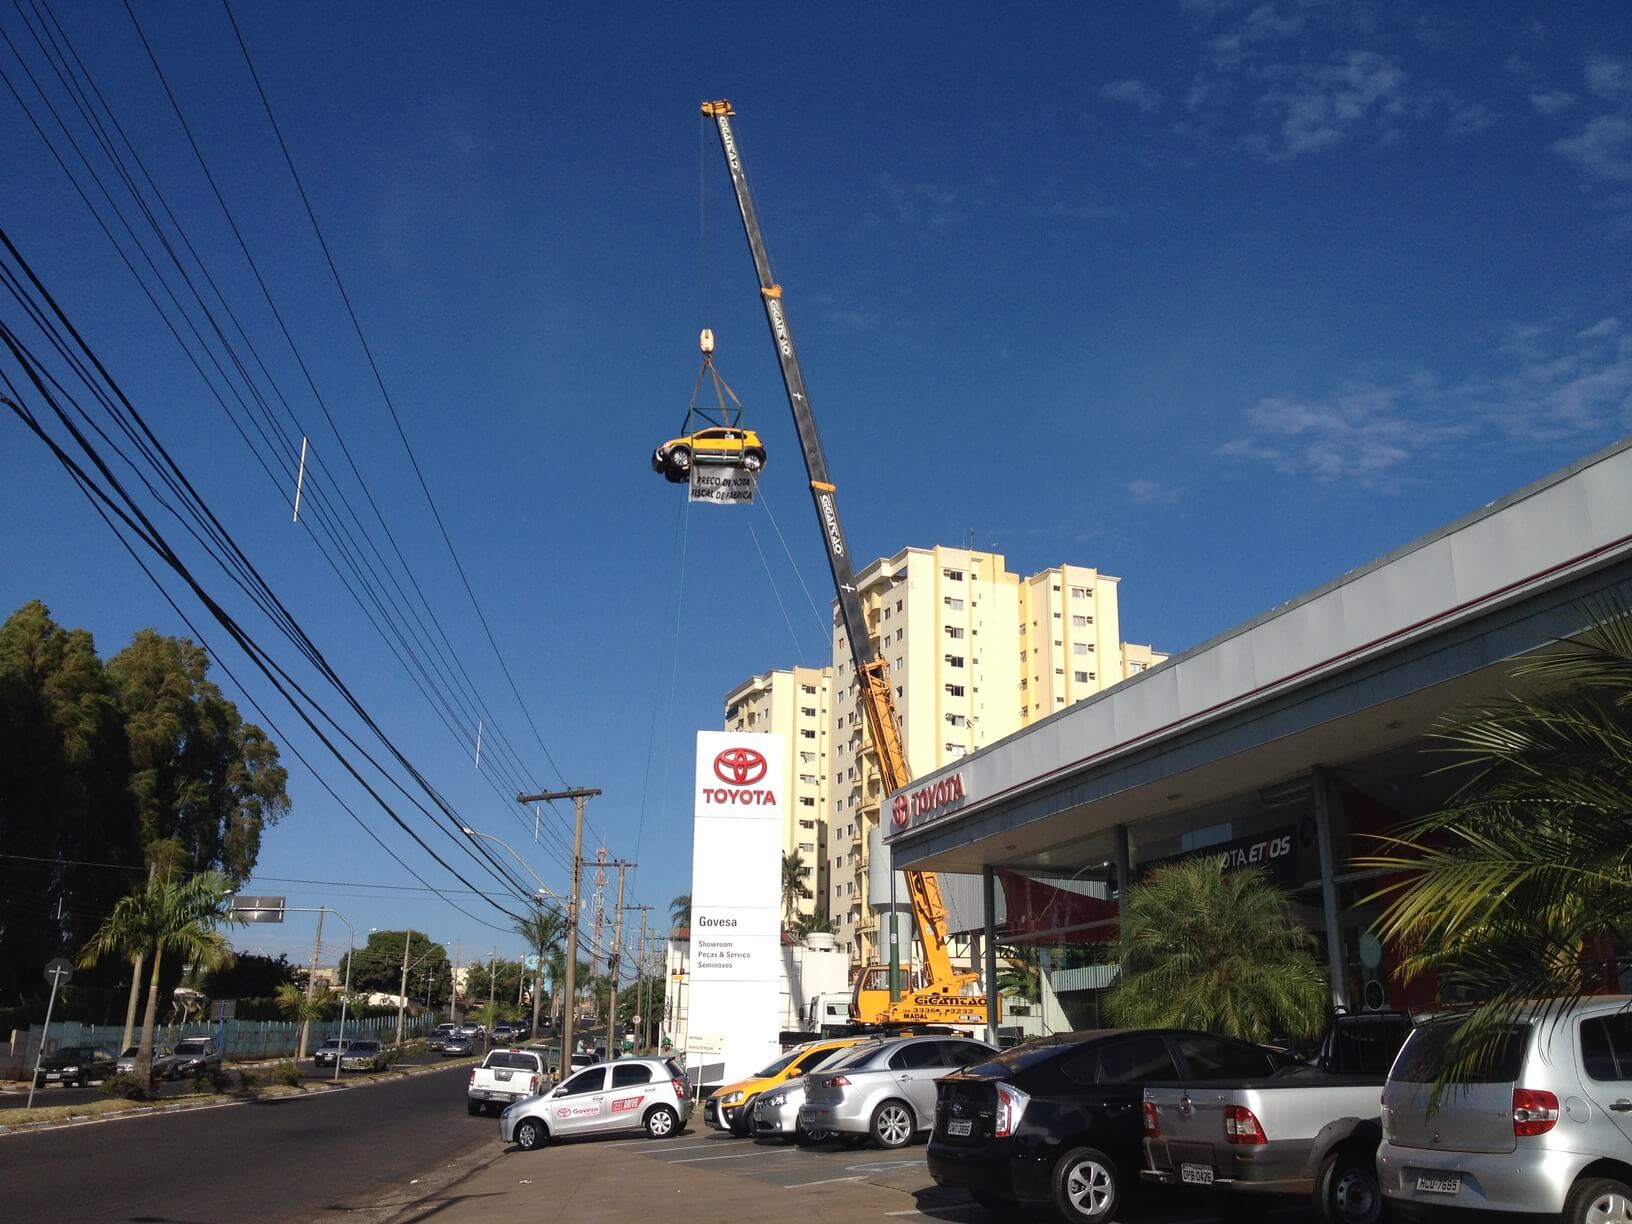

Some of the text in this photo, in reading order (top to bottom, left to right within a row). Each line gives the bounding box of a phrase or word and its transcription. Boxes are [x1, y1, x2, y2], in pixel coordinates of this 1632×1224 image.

[722, 478, 732, 487] DE
[733, 478, 750, 487] NOTA
[691, 489, 714, 498] FISCAL
[716, 491, 725, 500] DE
[703, 788, 777, 806] TOYOTA
[911, 771, 966, 816] TOYOTA
[699, 915, 738, 927] Govesa
[698, 940, 733, 948] Showroom
[697, 951, 718, 959] Peças
[726, 951, 751, 959] Serviço
[697, 961, 733, 969] Seminovos
[613, 1097, 640, 1111] TEST DRIVE
[572, 1107, 599, 1115] Govesa
